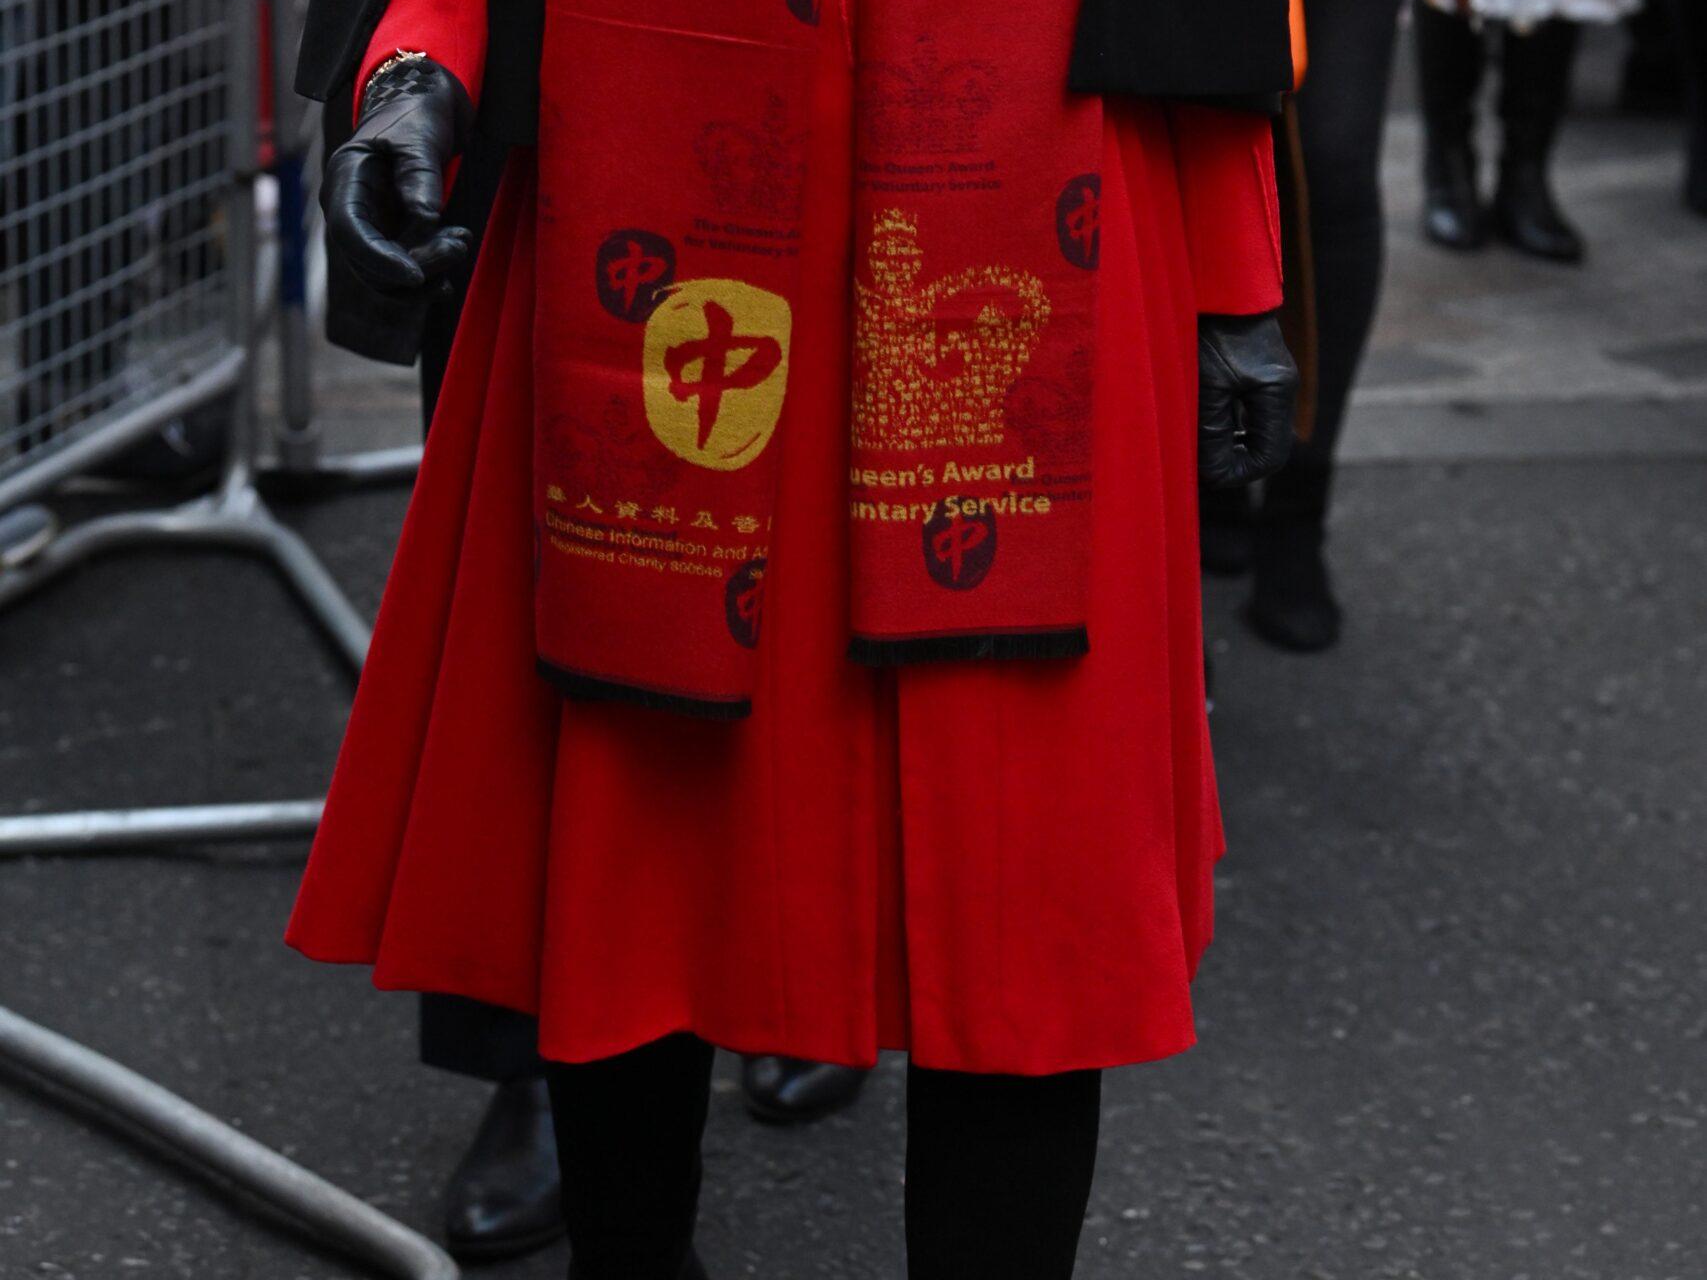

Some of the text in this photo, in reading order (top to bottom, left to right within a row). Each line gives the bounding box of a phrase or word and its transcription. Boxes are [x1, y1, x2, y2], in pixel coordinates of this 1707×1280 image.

[607, 240, 667, 313] 中
[664, 299, 782, 451] 中
[942, 455, 1035, 484] Award
[944, 490, 1052, 519] Service
[609, 525, 707, 557] Information
[712, 544, 748, 561] and
[933, 518, 988, 583] 中
